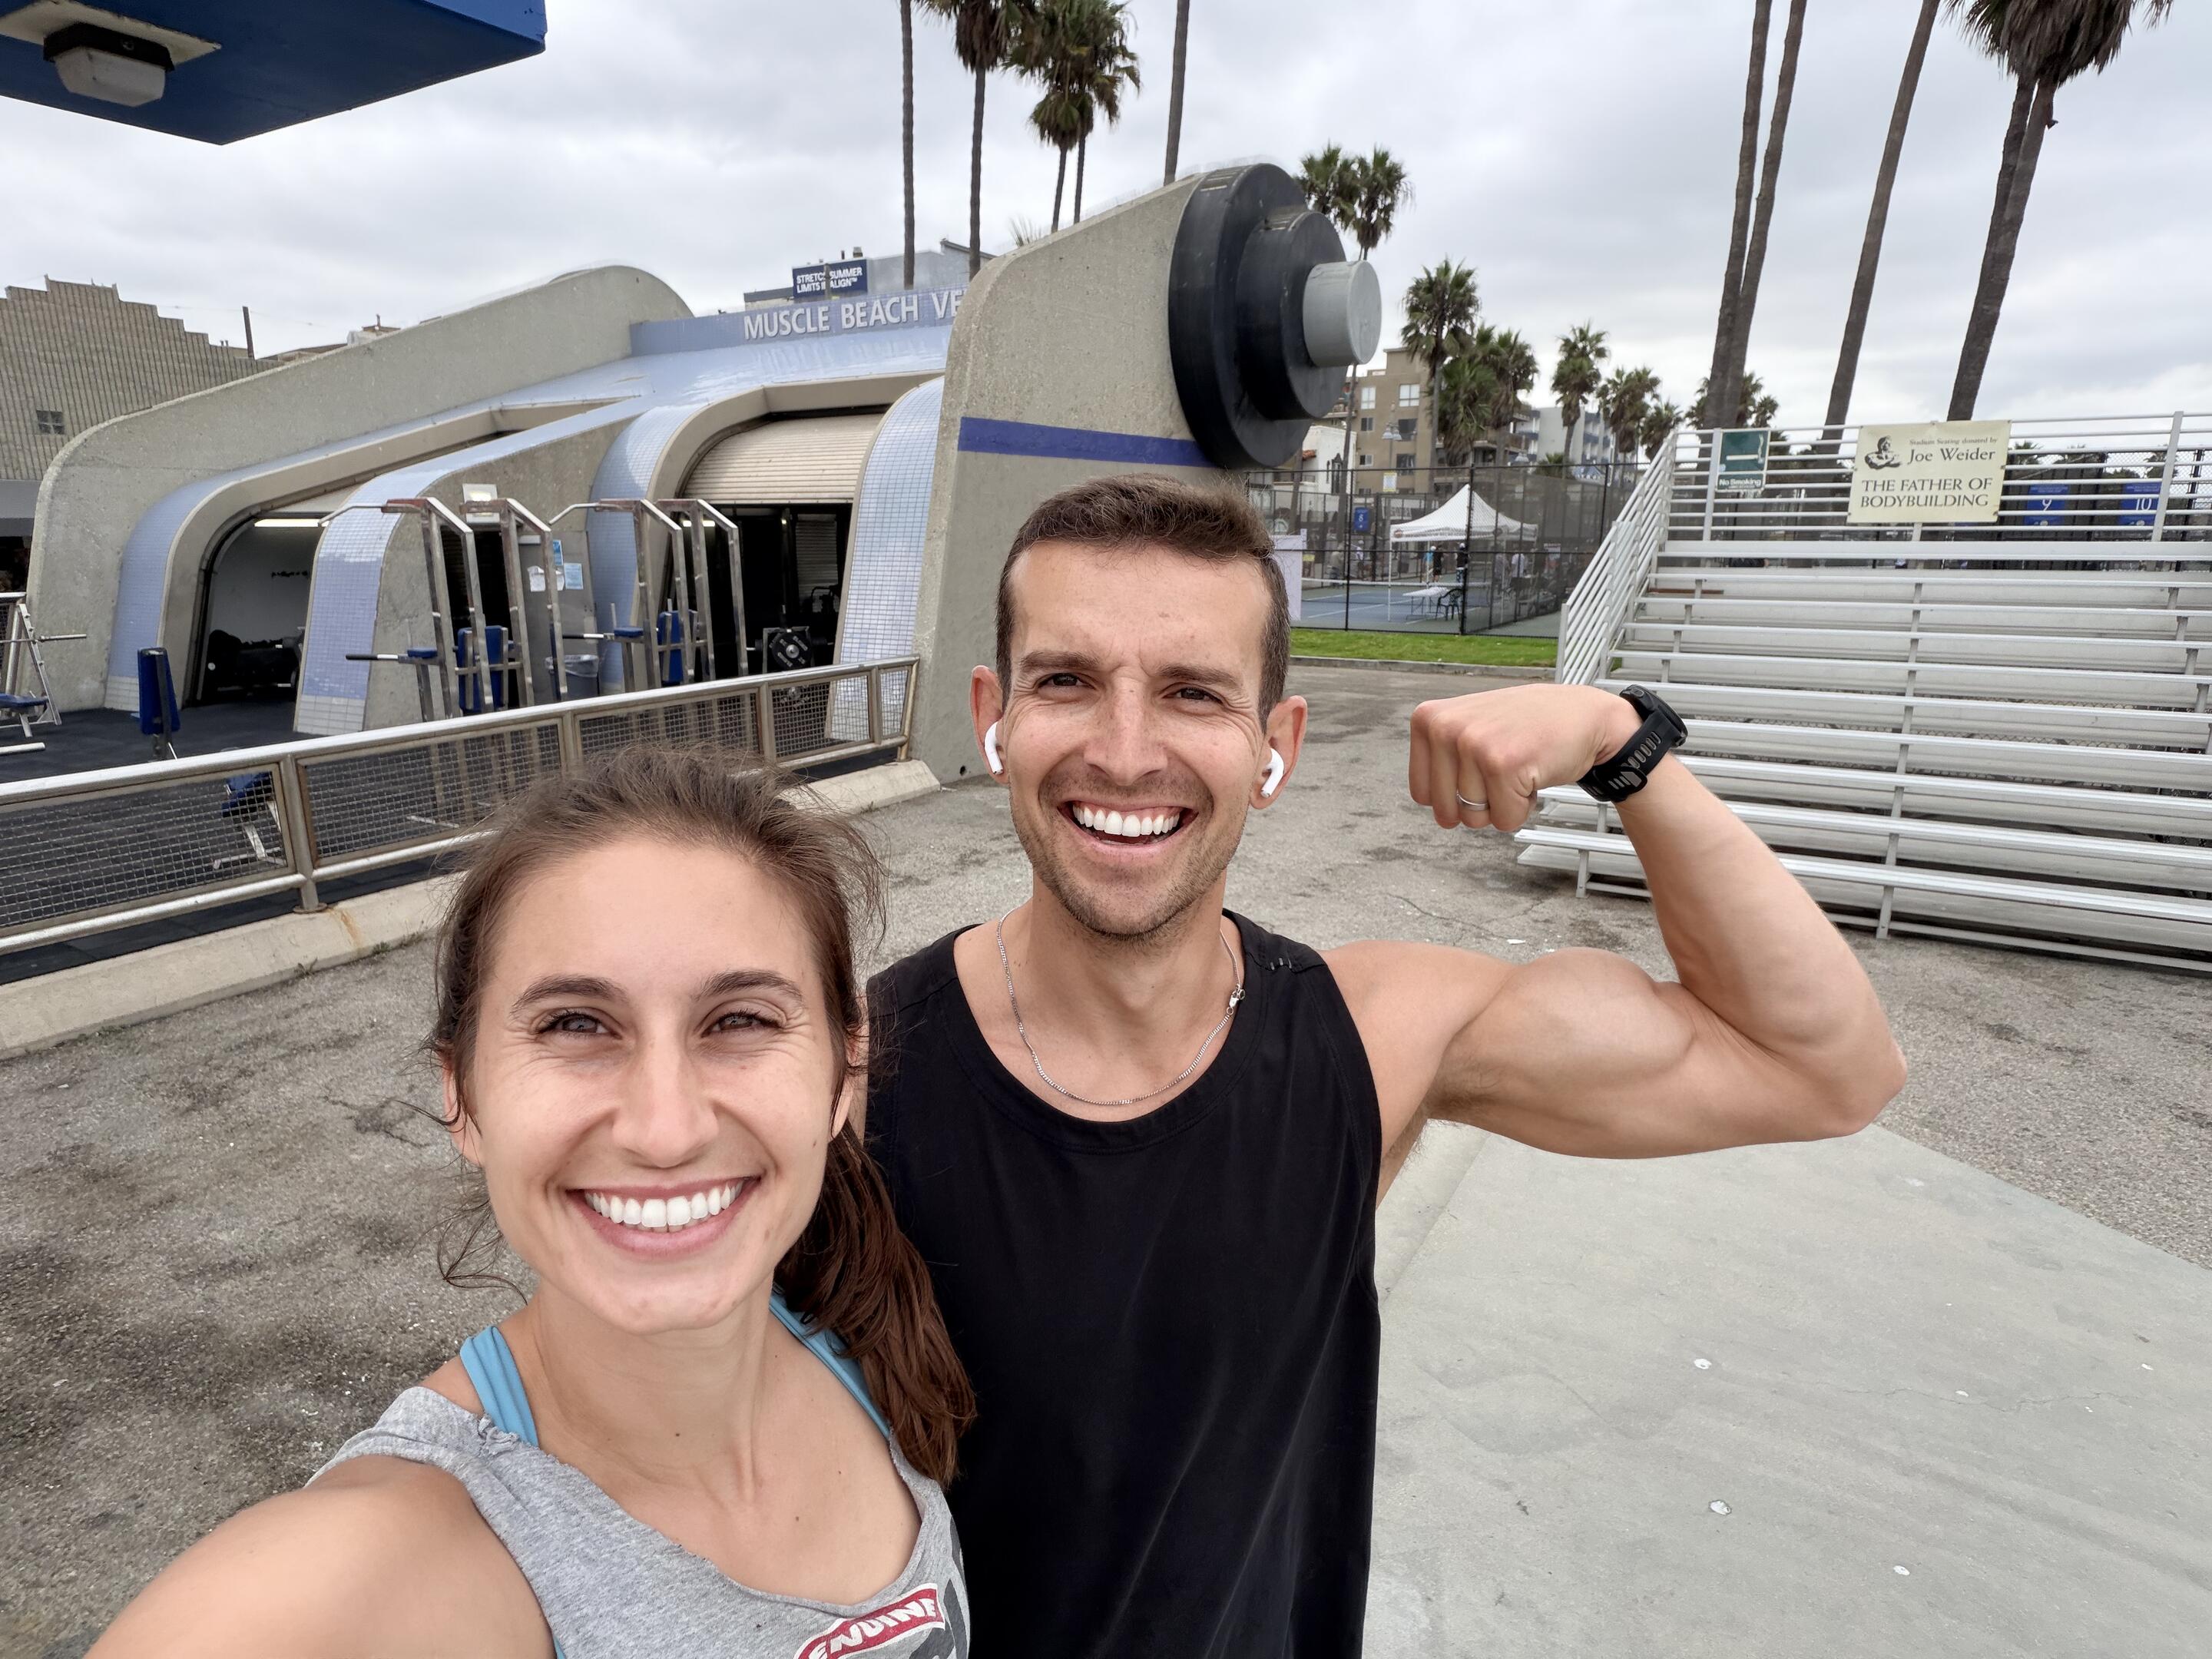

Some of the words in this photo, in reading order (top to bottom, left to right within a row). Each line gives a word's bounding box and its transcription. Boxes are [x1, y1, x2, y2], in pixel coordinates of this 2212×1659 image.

[830, 267, 863, 280] SUMMER
[796, 282, 820, 293] LIMITS
[743, 306, 830, 339] MUSCLE
[841, 294, 919, 329] BEACH
[930, 289, 967, 319] VE
[1907, 449, 1933, 465] Joe
[1940, 447, 1995, 461] Weider
[1730, 478, 1762, 488] Smoking
[1862, 479, 1896, 492] THE
[1900, 478, 1962, 492] FATHER
[1969, 478, 1993, 491] OF
[1860, 494, 1988, 508] BODYBUILDING
[2041, 498, 2052, 512] 9
[2135, 498, 2152, 511] 10
